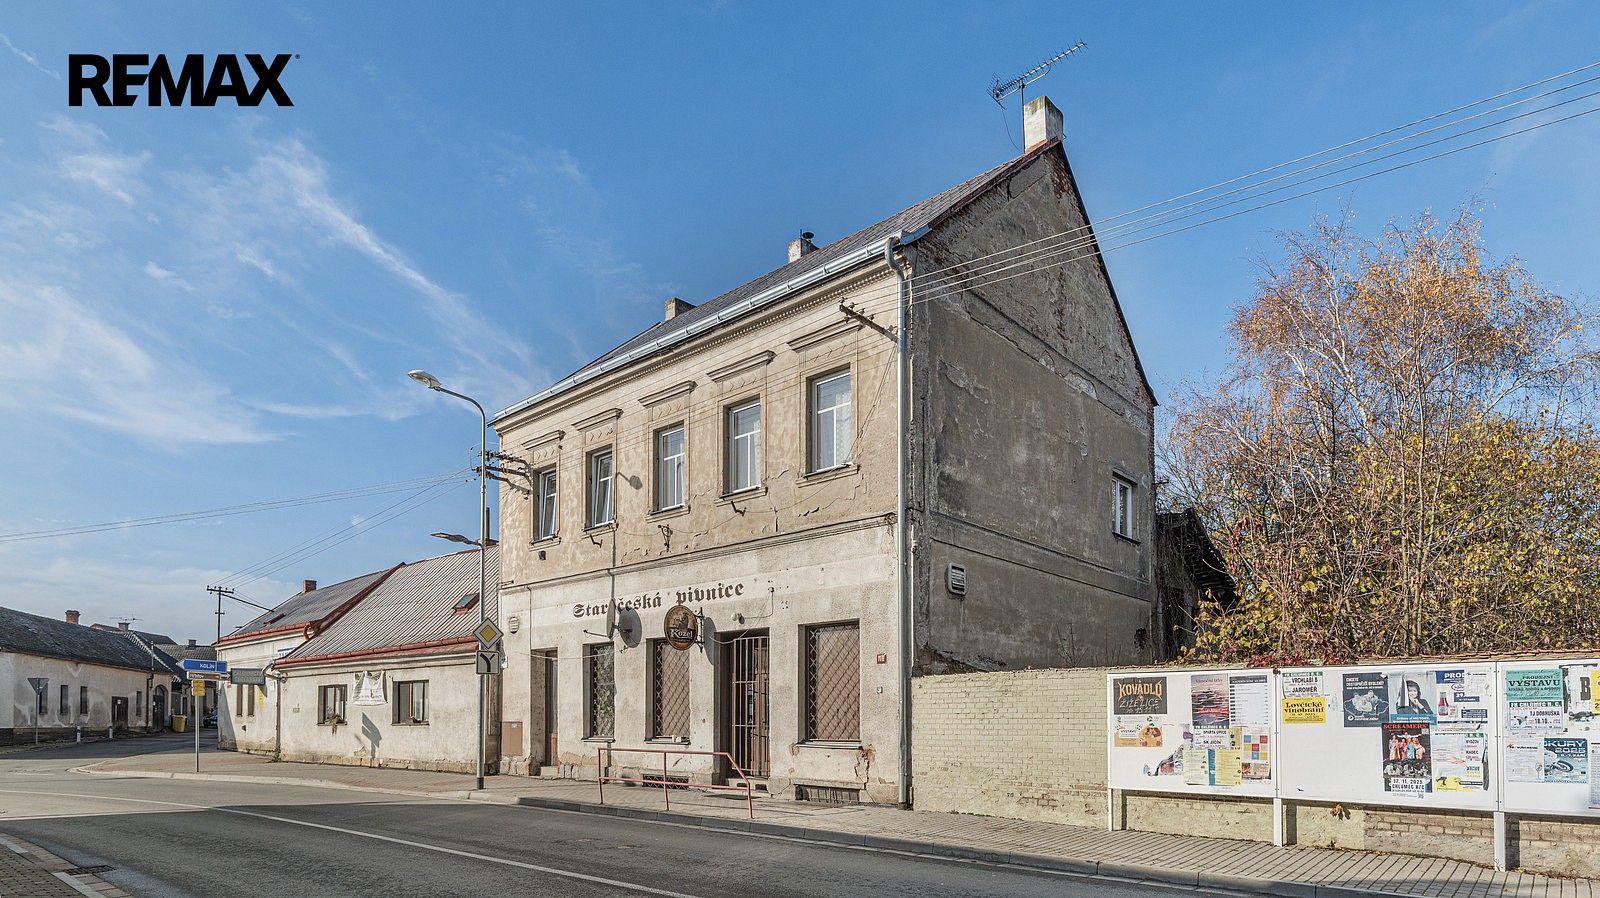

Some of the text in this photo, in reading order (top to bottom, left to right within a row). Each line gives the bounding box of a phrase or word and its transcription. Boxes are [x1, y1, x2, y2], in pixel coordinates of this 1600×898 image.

[572, 582, 745, 618] Starčeská pivnice
[670, 628, 694, 640] Kozel
